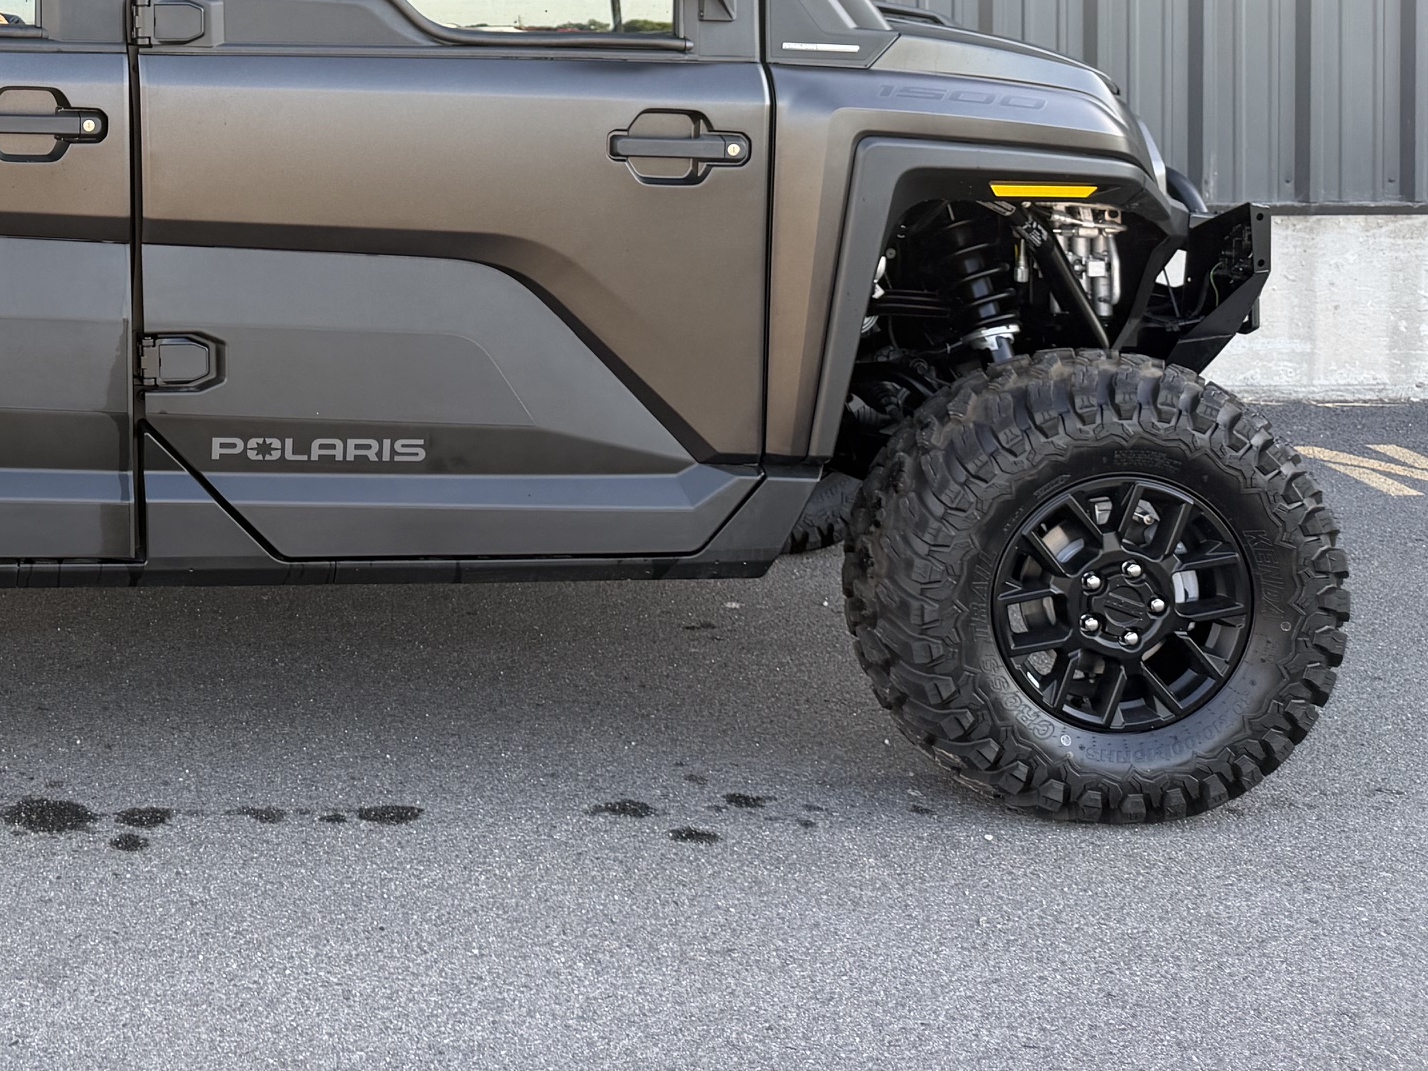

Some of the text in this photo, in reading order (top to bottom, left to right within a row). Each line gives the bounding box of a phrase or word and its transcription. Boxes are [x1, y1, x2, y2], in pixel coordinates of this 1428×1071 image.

[878, 85, 1048, 110] 1500
[211, 437, 427, 462] POLARIS
[1242, 529, 1285, 619] KENDA
[970, 551, 1056, 740] CROSS TRAIL
